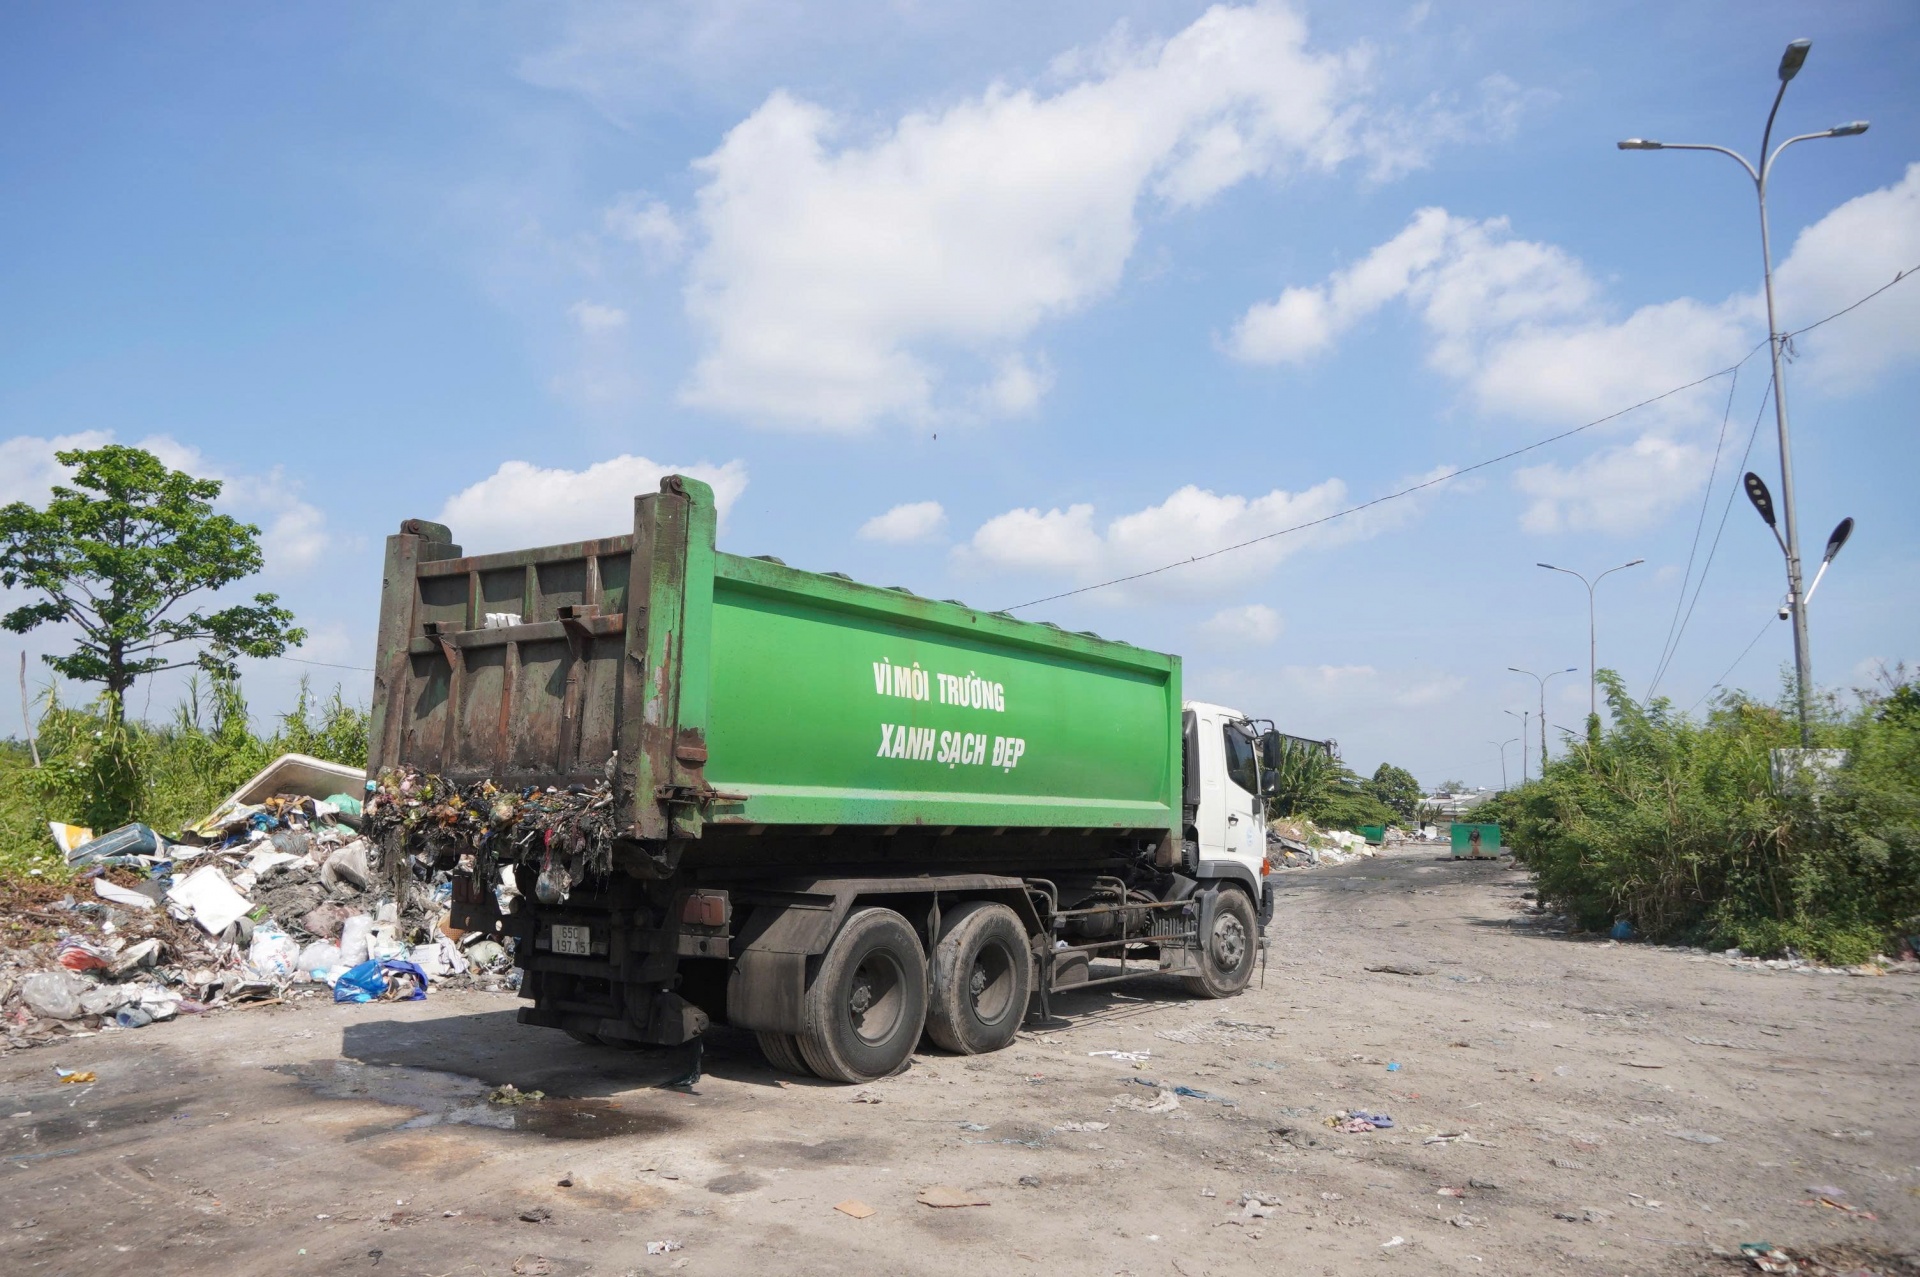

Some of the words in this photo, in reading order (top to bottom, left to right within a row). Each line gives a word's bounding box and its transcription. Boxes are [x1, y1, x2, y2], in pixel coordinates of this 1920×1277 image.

[873, 657, 892, 696] VÌ
[894, 662, 930, 701] MÔI
[936, 670, 1005, 712] TRƯỜNG
[876, 723, 936, 761] XANH
[936, 730, 987, 769] SẠCH
[991, 736, 1026, 773] ĐẸP
[557, 940, 586, 953] 197.15
[562, 926, 578, 939] 65C
